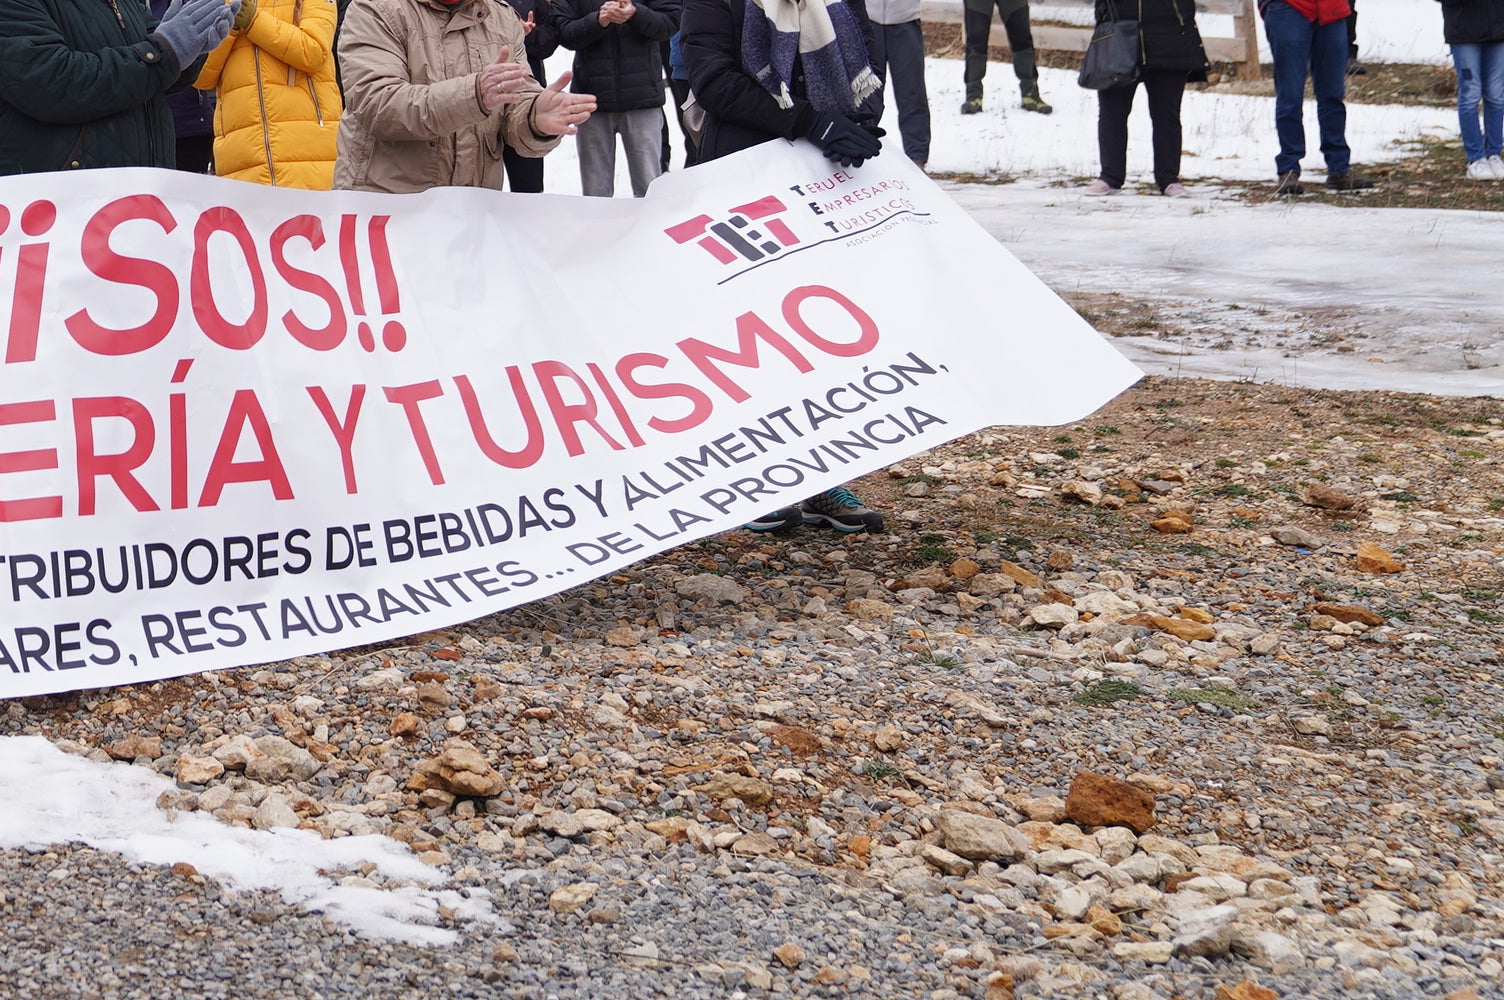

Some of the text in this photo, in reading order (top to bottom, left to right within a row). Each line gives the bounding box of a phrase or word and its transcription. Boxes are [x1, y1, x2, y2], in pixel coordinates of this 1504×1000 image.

[789, 170, 854, 196] TERUEL
[306, 384, 366, 495] Y
[382, 285, 880, 485] TURISMO
[326, 524, 376, 571] DE
[383, 488, 575, 561] BEBIDAS
[576, 480, 607, 518] Y
[624, 352, 949, 511] ALIMENTACIÓN,
[567, 530, 642, 567] DE
[634, 509, 713, 542] LA
[703, 405, 948, 514] PROVINCIA
